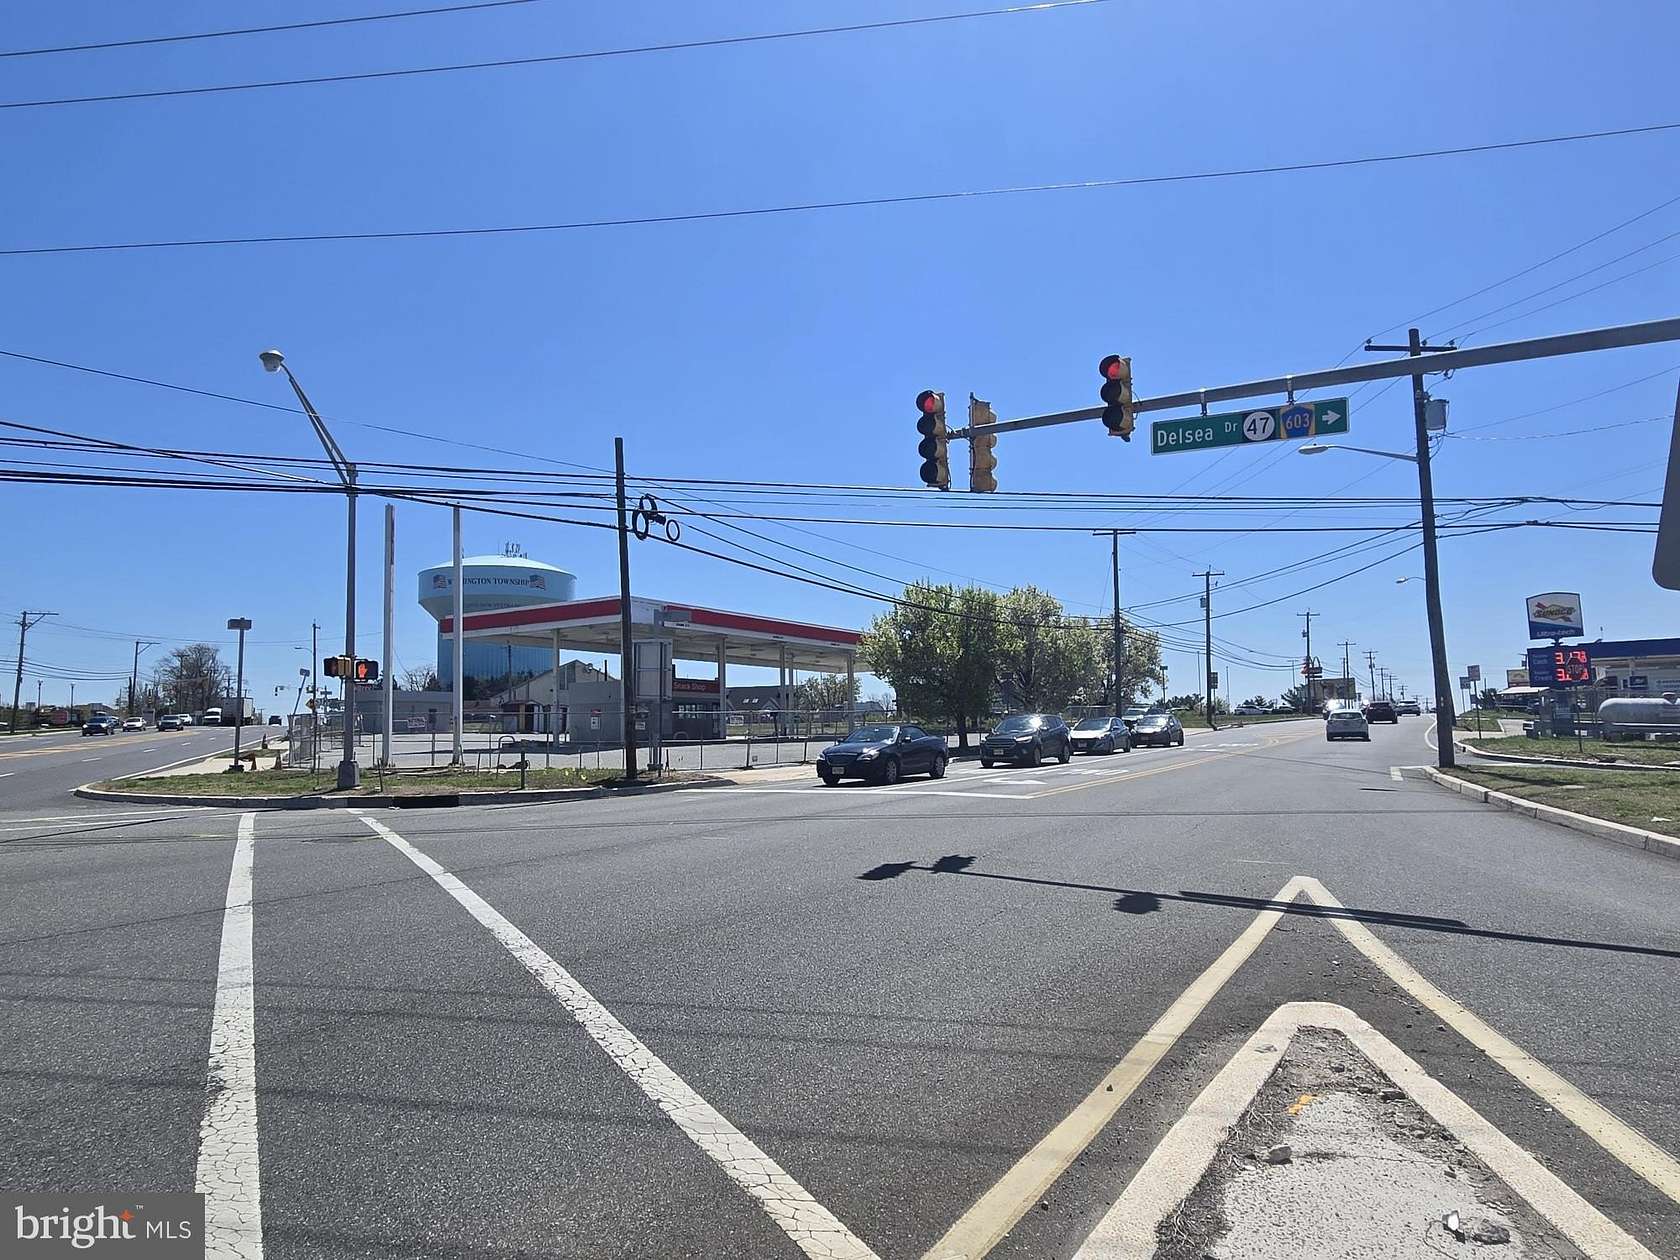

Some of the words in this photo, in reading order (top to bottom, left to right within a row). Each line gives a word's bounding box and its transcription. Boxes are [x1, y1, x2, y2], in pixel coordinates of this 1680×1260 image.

[1246, 416, 1270, 435] 47
[1285, 413, 1310, 429] 603
[1157, 427, 1214, 447] Delsea
[1225, 422, 1238, 433] Dr
[493, 577, 530, 586] TOWNSHIP
